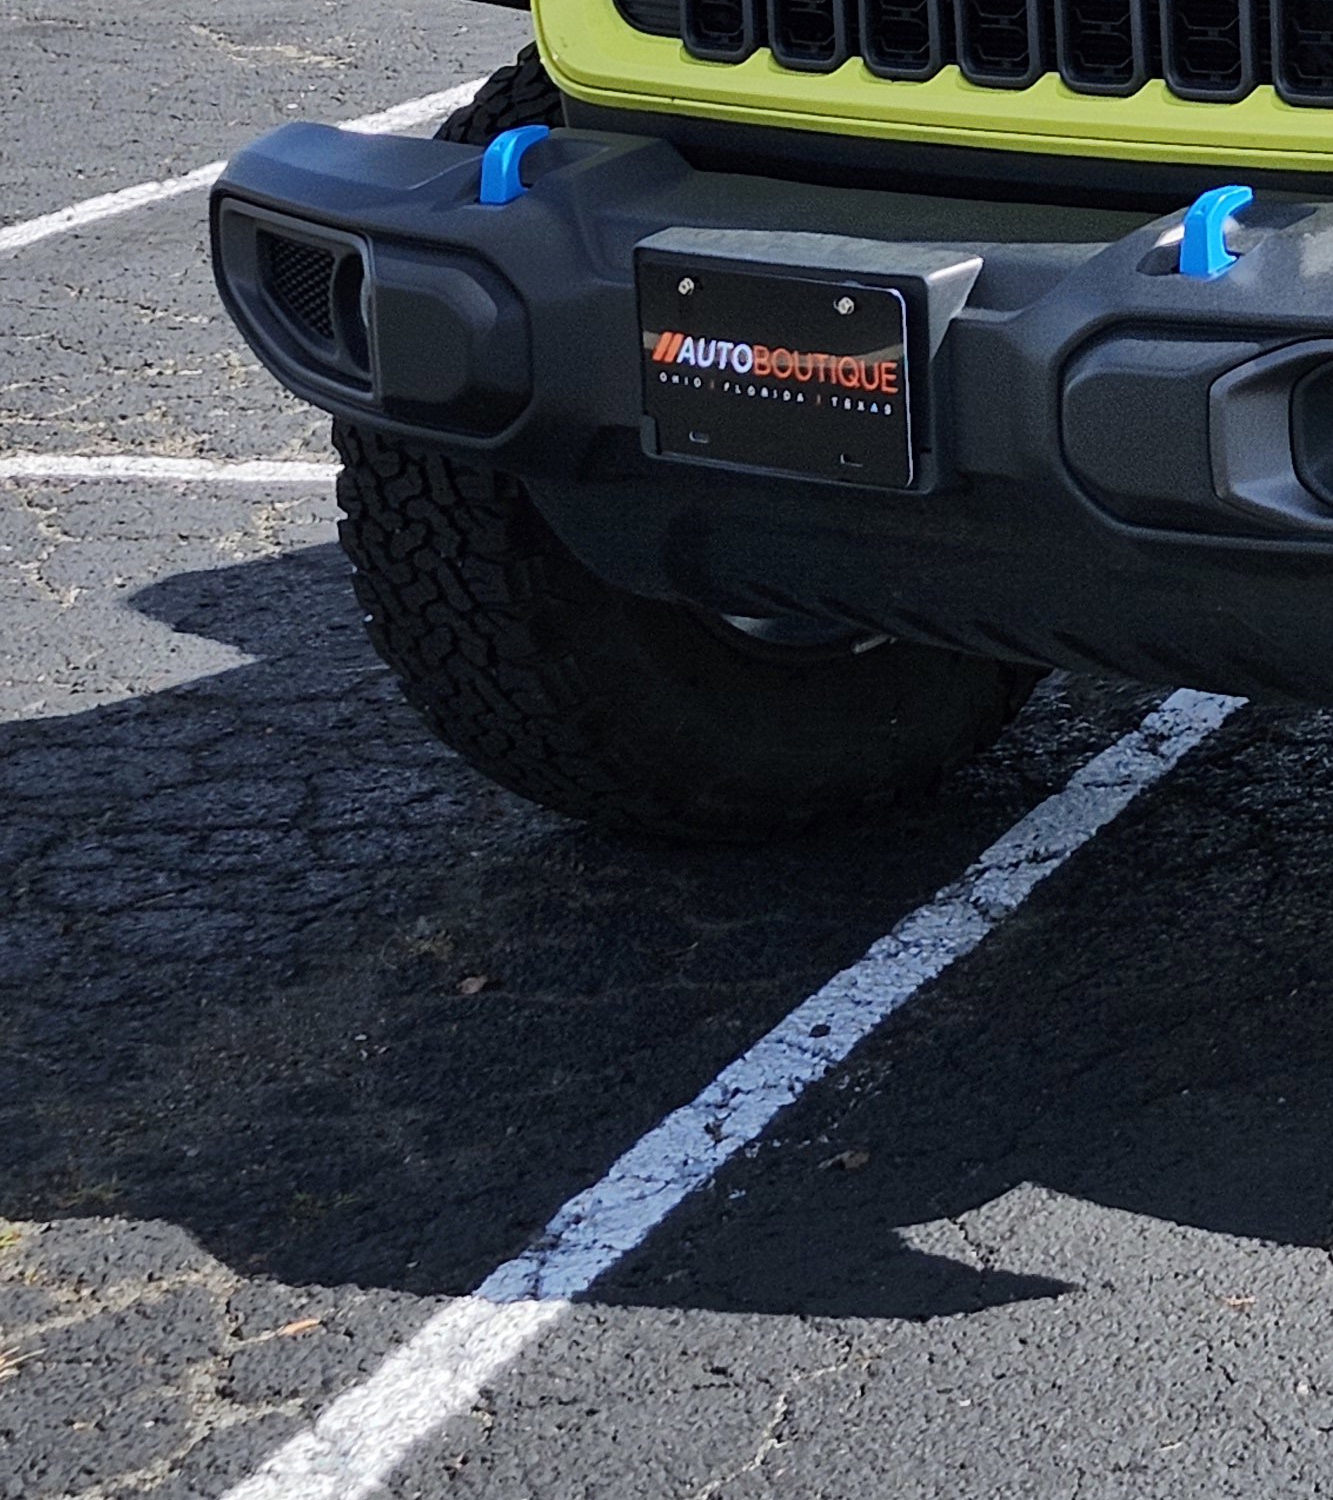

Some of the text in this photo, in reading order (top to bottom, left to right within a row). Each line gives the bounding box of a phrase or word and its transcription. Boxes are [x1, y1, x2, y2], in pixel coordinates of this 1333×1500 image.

[676, 336, 899, 393] AUTOBOUTIQUE
[659, 372, 702, 388] OHIO
[831, 397, 892, 416] TEXAS
